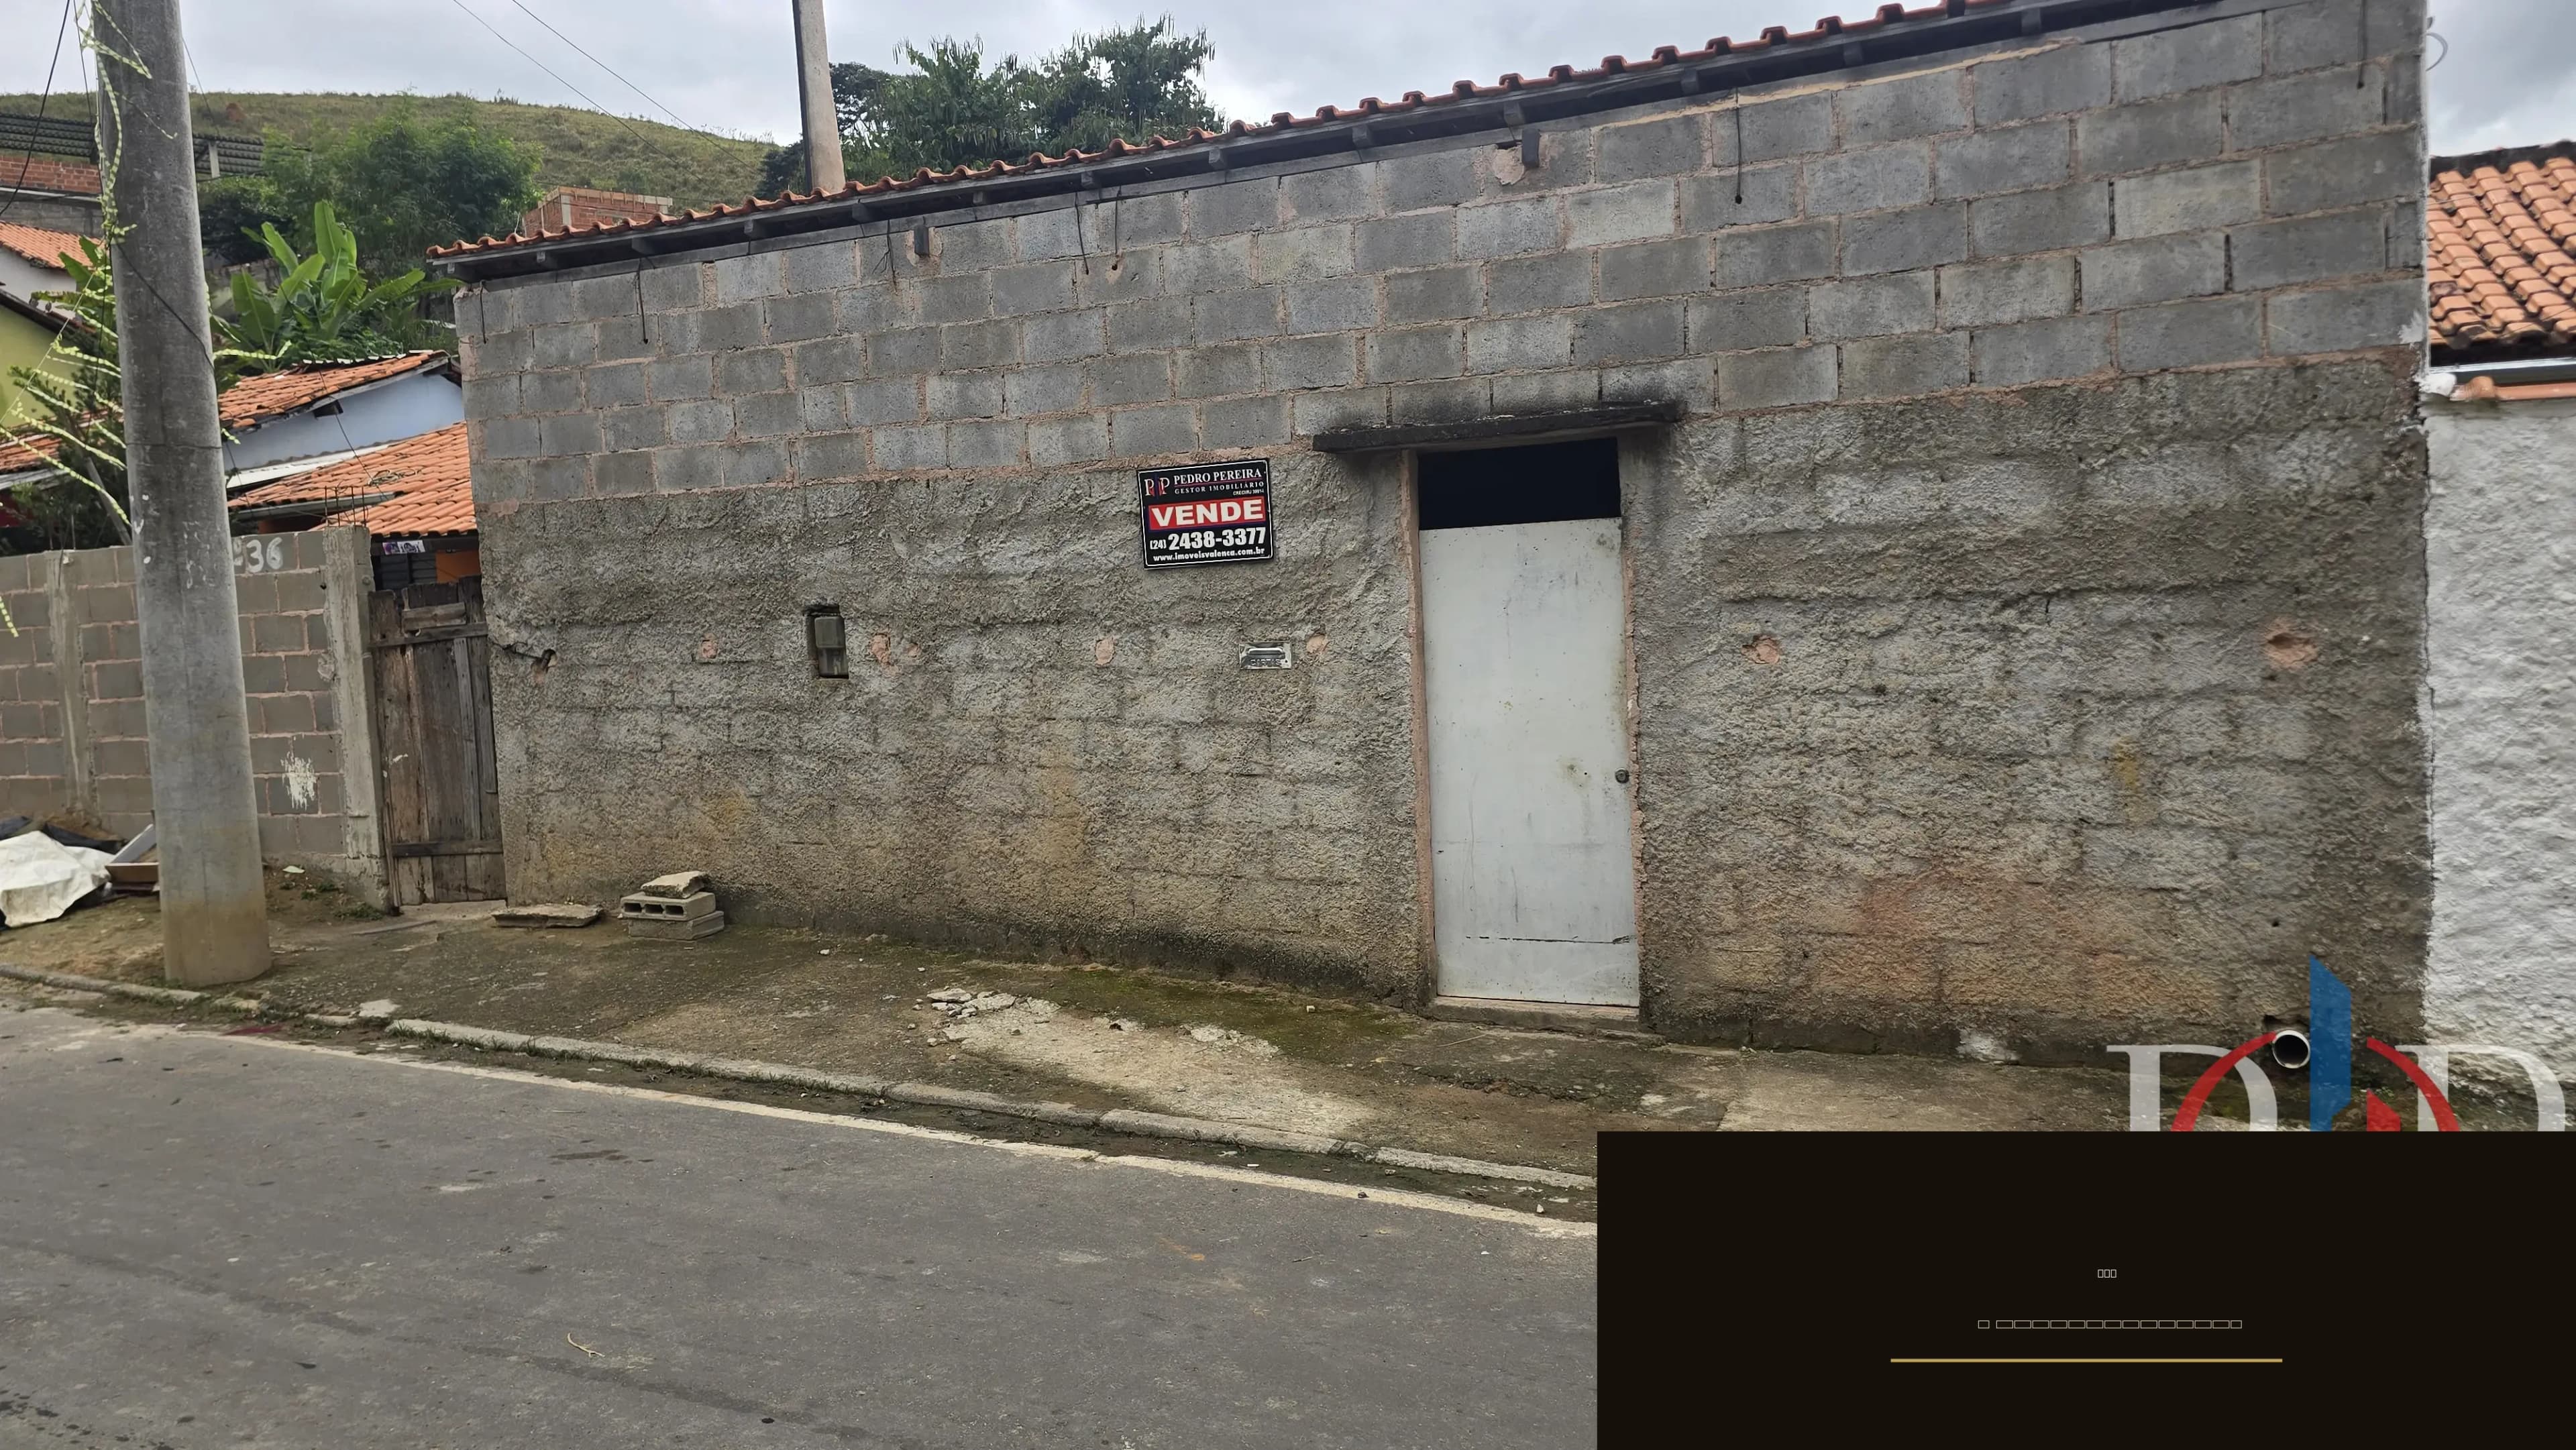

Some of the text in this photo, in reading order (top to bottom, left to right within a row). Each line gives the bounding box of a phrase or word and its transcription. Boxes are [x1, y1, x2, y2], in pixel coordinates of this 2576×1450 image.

[1173, 468, 1262, 485] PEDRO PEREIRA
[1175, 486, 1206, 494] GESTOR
[1151, 499, 1263, 526] VENDE
[1150, 527, 1267, 551] (24) 2438-3377
[1153, 546, 1265, 561] www.imoveisvalenca.com.br
